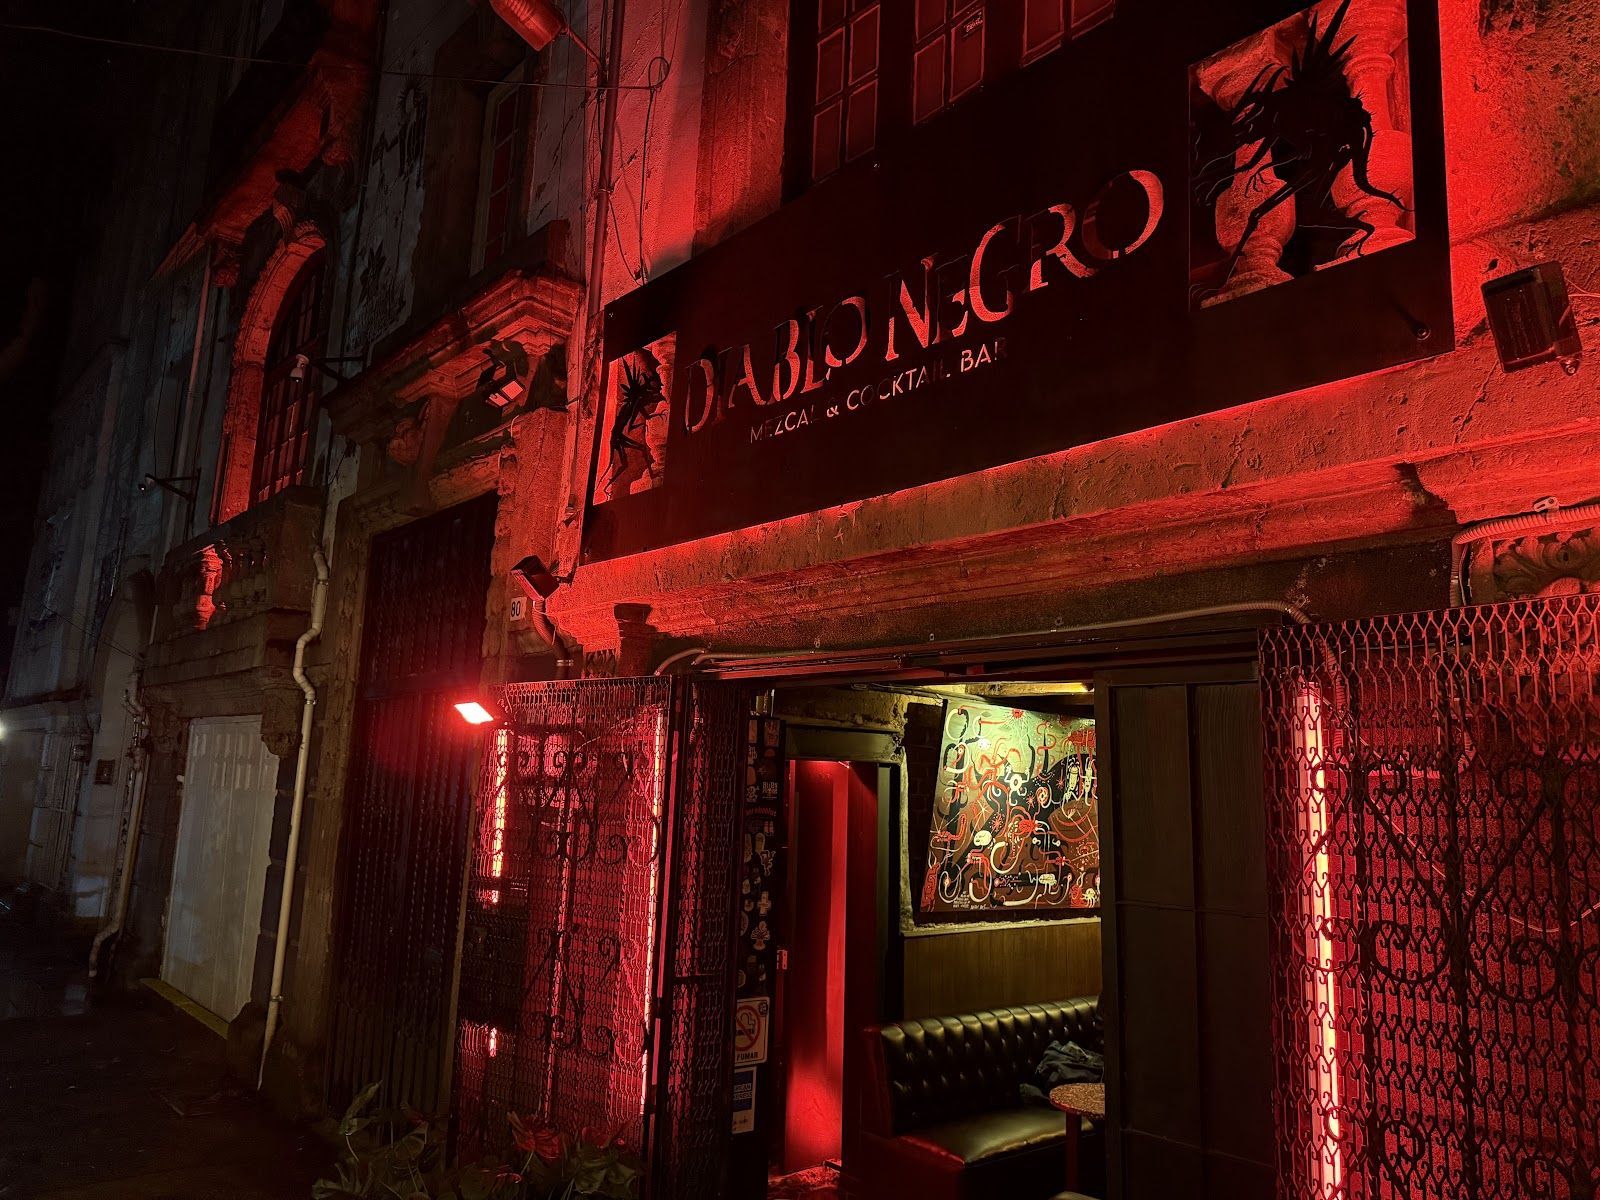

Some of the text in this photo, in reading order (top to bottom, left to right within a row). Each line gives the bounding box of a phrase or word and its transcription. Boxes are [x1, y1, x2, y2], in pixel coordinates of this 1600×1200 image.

[684, 169, 1164, 433] DIABLO NEGRO
[826, 399, 840, 418] &
[511, 600, 521, 617] 80
